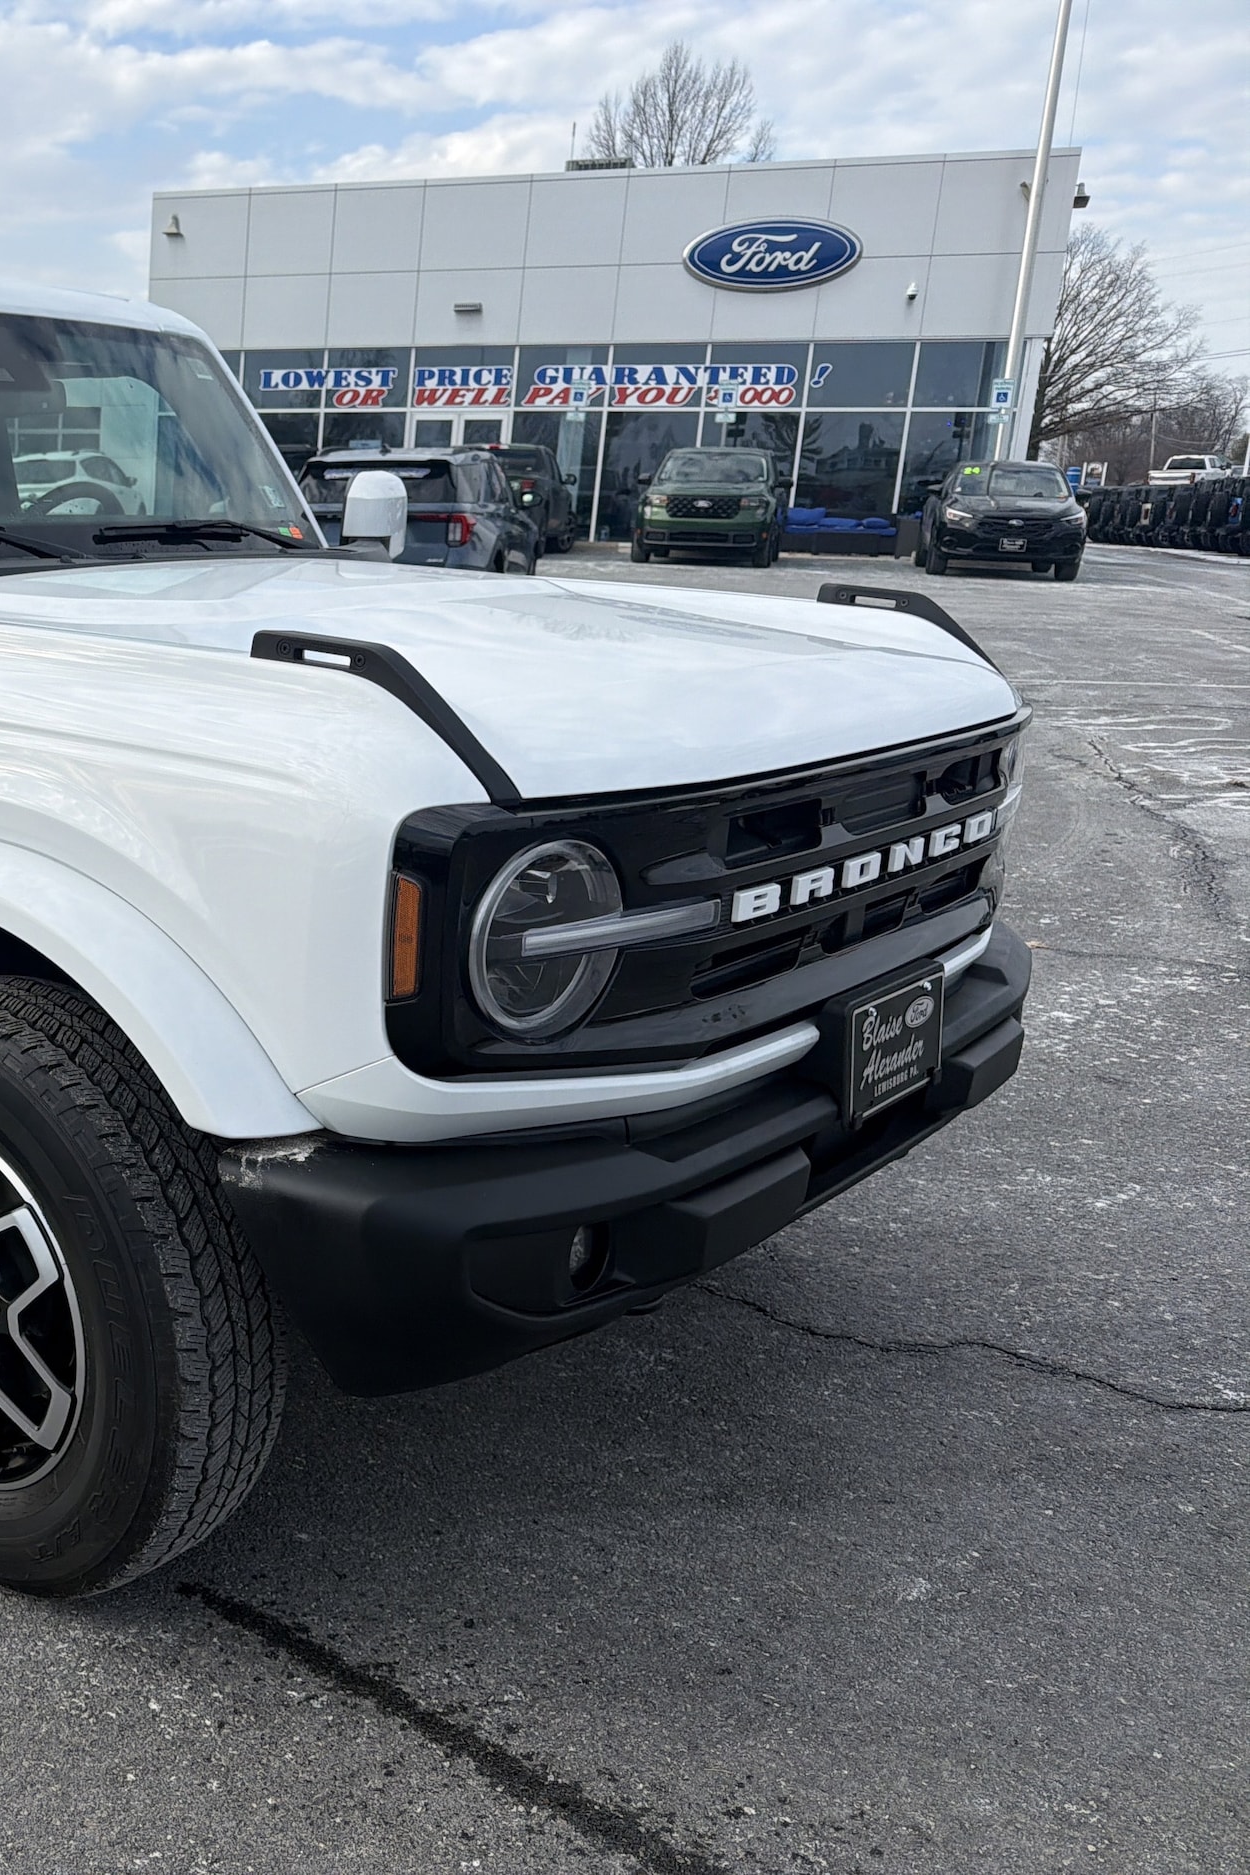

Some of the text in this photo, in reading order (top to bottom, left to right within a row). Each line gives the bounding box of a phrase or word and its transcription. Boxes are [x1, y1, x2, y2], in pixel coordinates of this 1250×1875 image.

[720, 233, 822, 273] Ford
[261, 369, 397, 389] LOWEST
[415, 368, 512, 387] PRICE
[536, 365, 797, 386] GUARANTEED
[333, 388, 387, 407] OR
[613, 386, 696, 405] YOU
[731, 810, 993, 923] BRONCO
[910, 1002, 929, 1023] Ford
[861, 1015, 904, 1052] Blaise
[859, 1033, 925, 1091] Alexander
[874, 1069, 908, 1097] LEWISBURG
